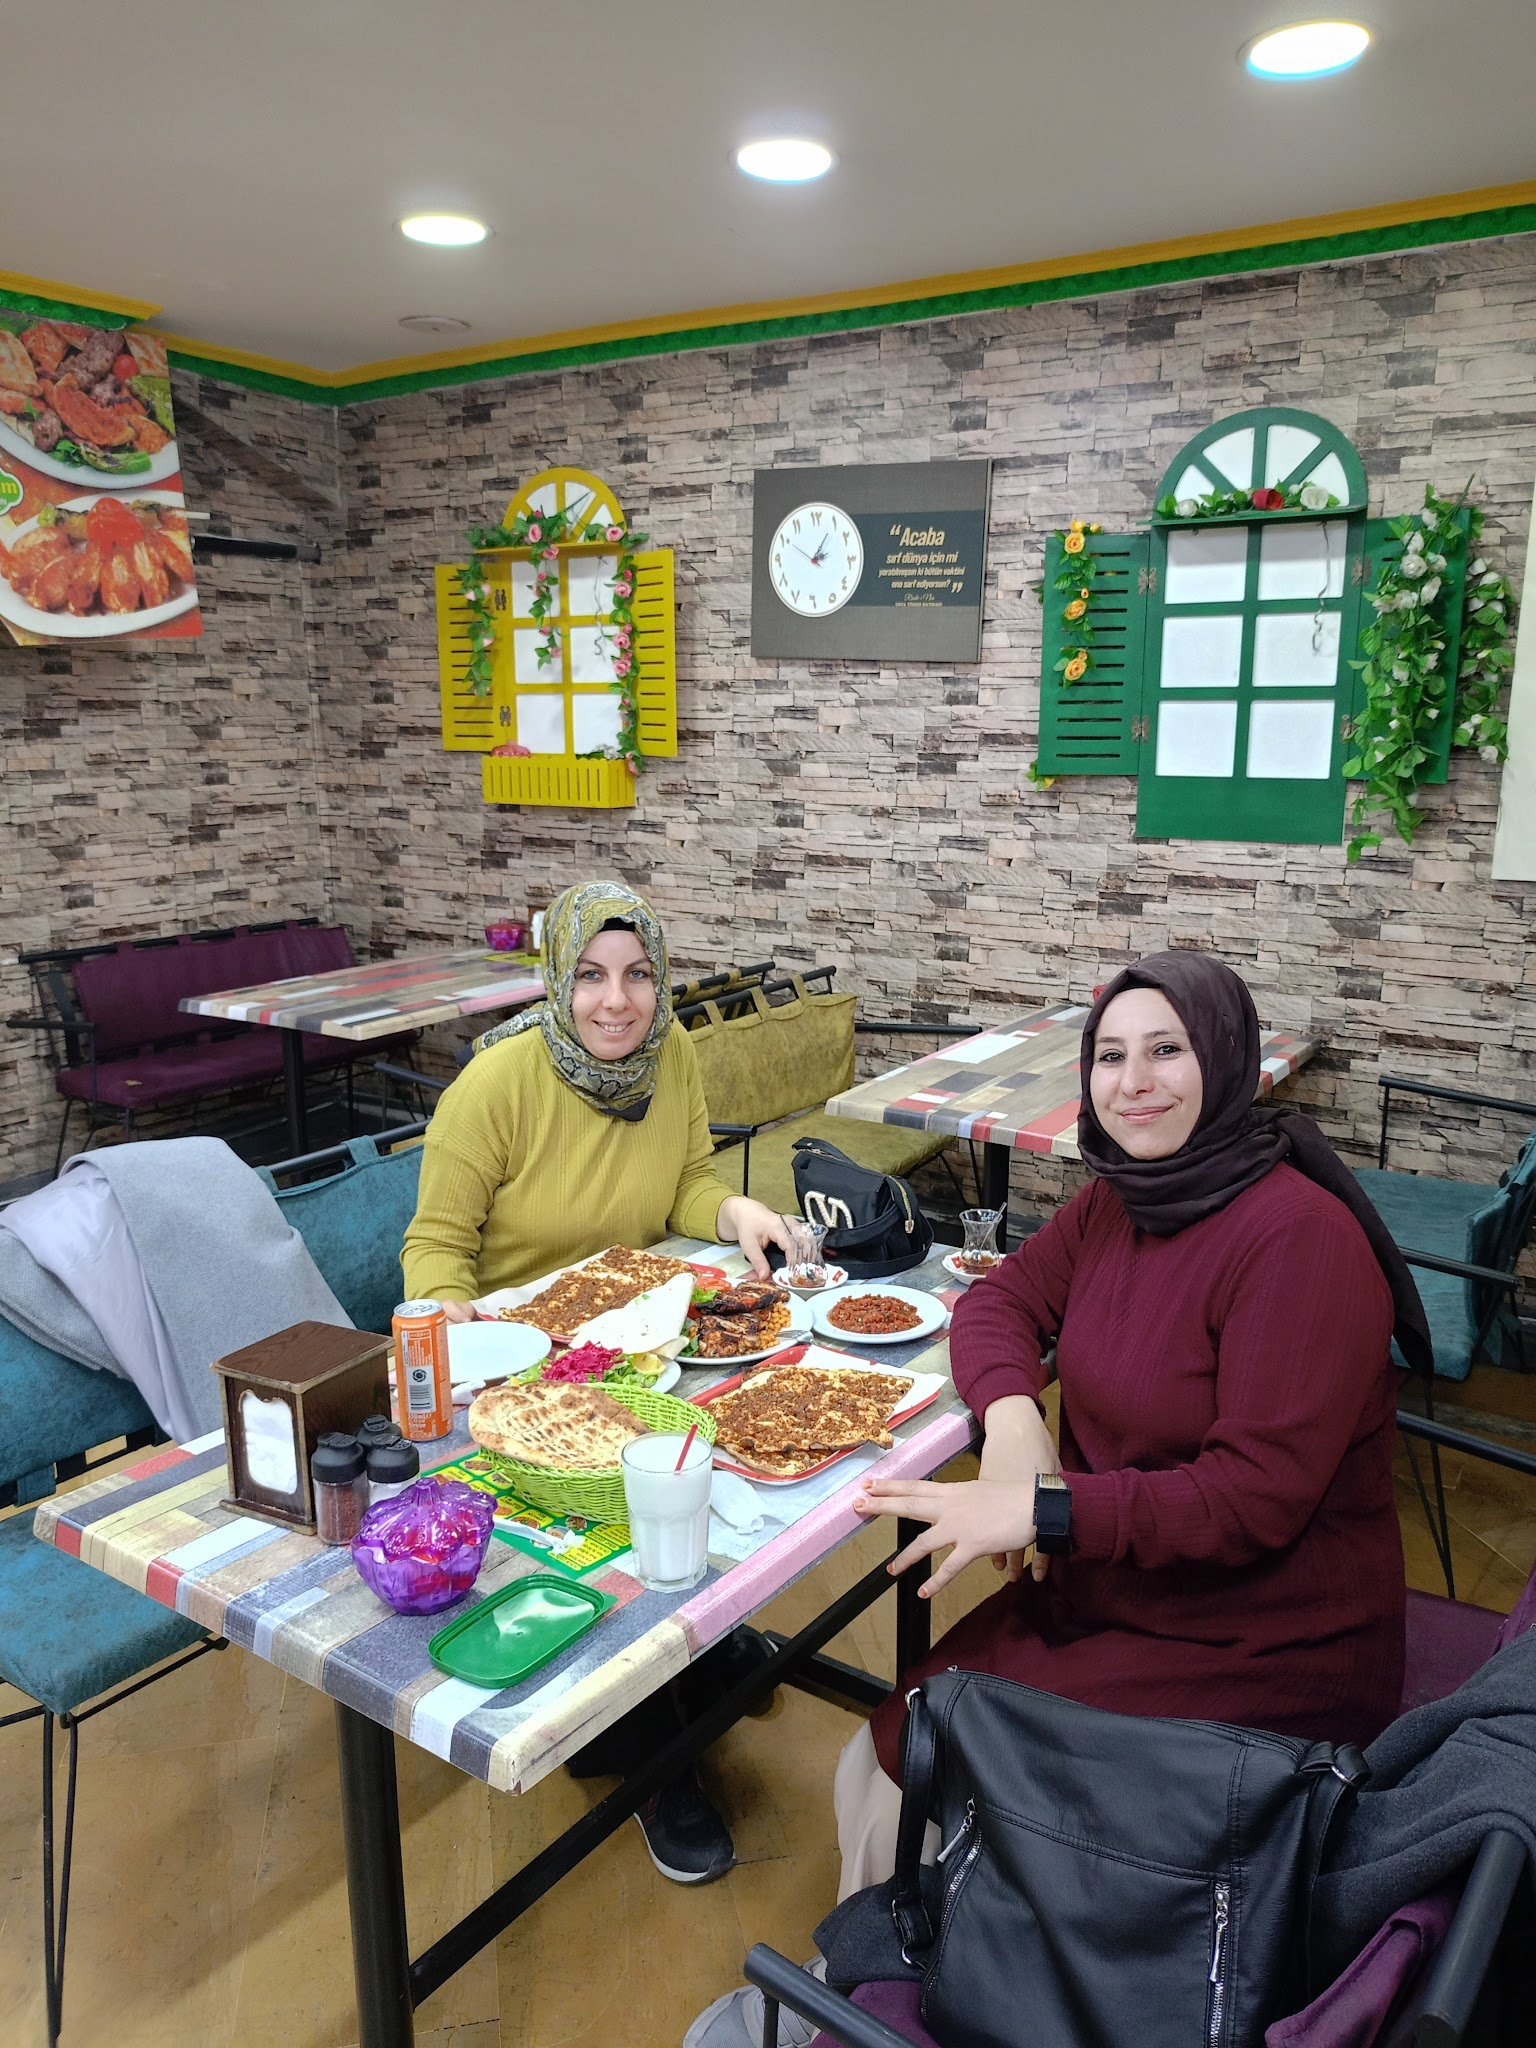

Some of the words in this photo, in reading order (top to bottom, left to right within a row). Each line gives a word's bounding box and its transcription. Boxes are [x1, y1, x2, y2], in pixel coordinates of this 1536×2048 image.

[902, 552, 928, 565] dünya
[929, 552, 945, 565] için
[945, 551, 959, 563] mi
